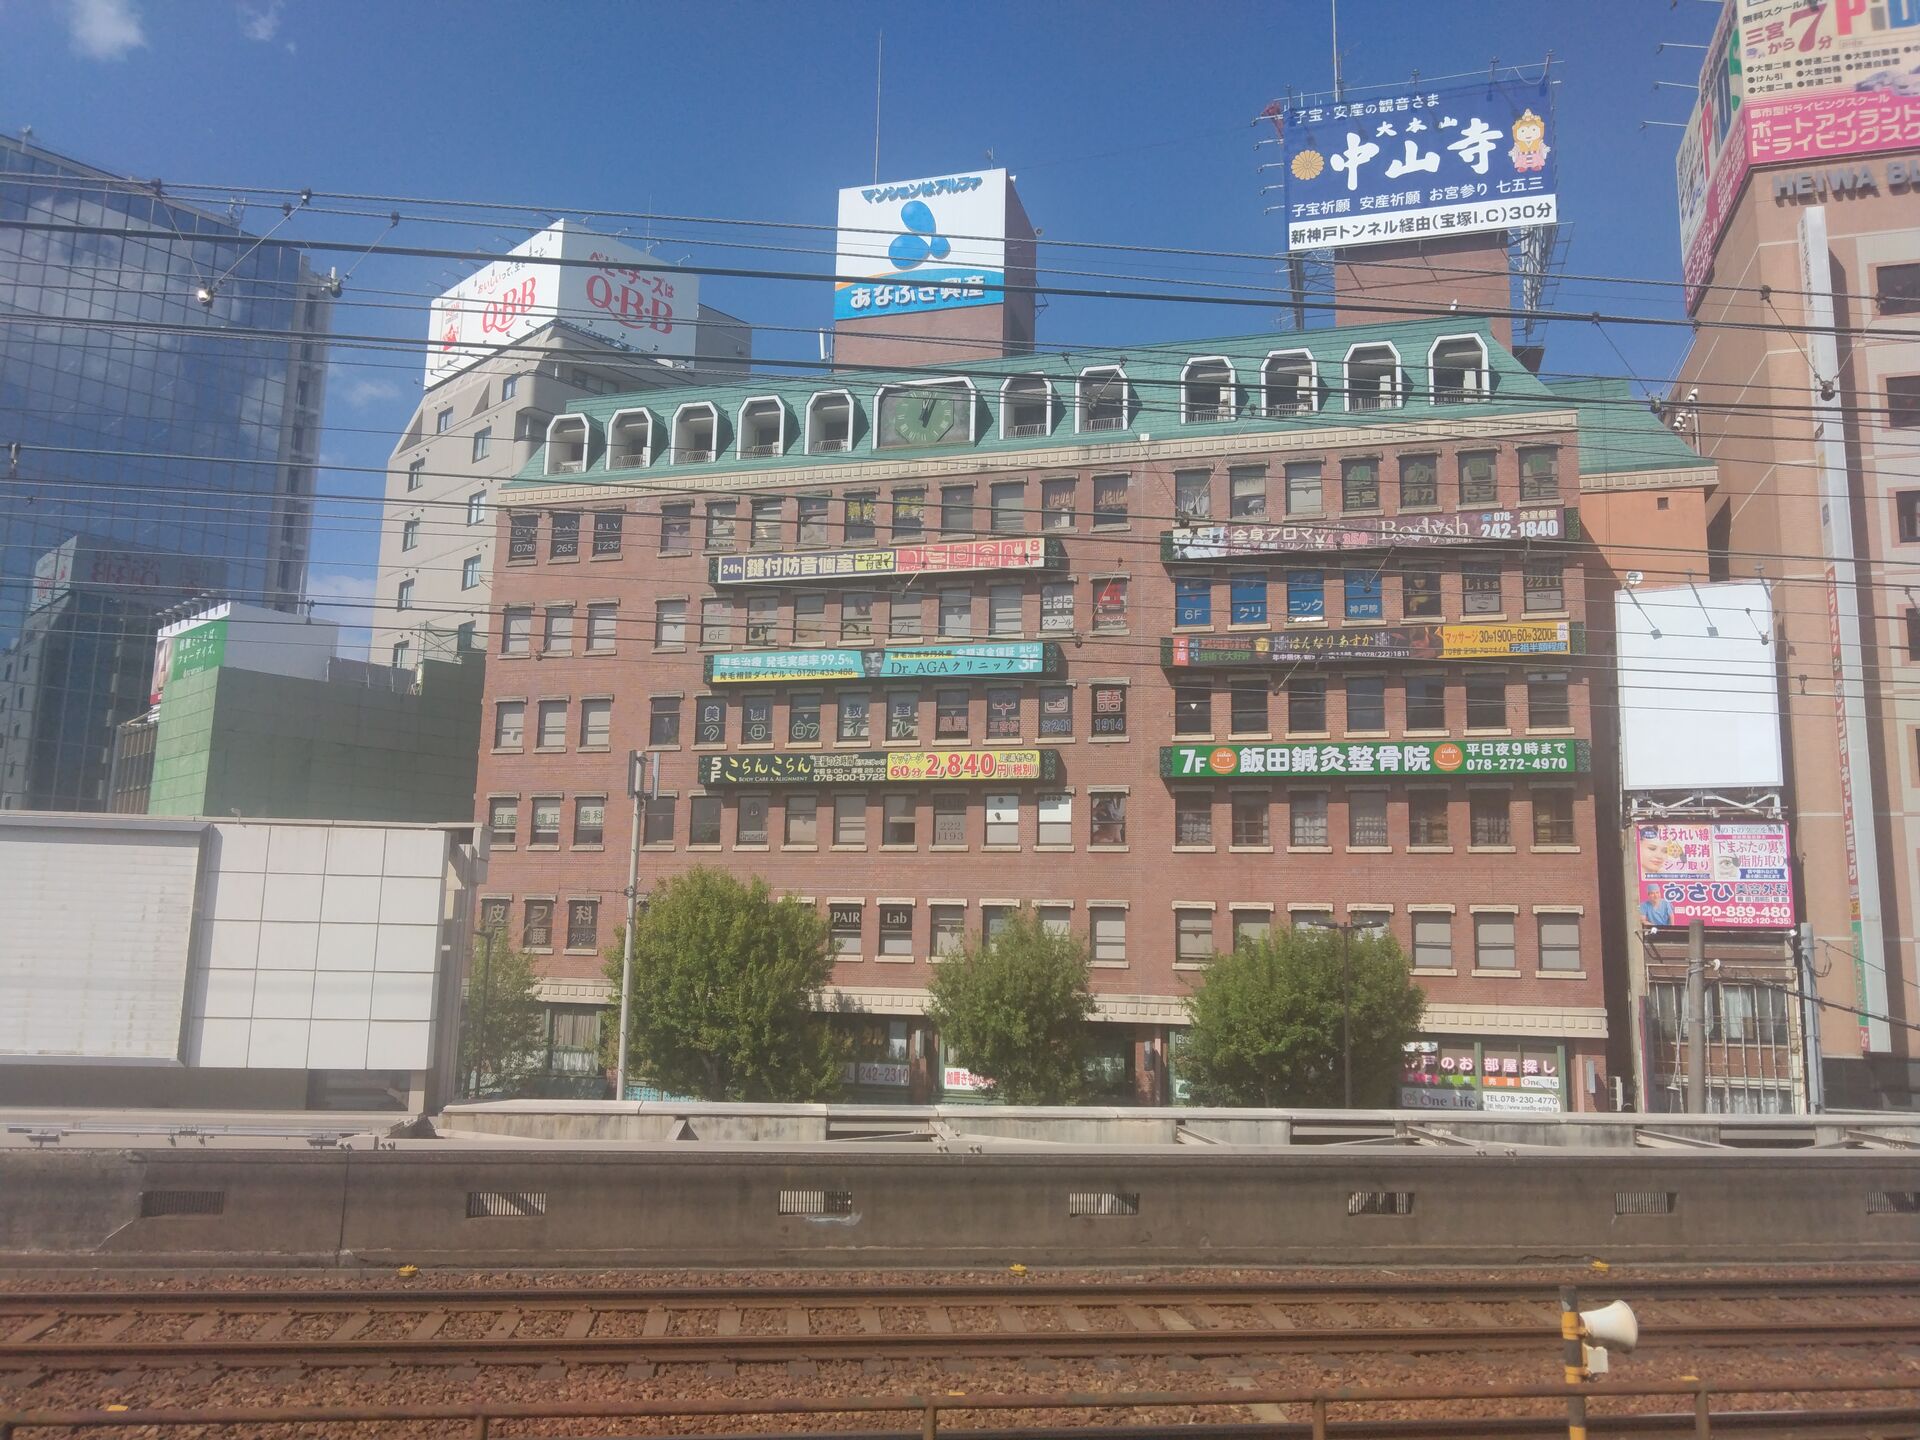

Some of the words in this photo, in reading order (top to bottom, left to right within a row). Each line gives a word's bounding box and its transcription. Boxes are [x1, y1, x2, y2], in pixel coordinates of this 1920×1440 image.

[1745, 21, 1785, 47] 三宮
[1768, 37, 1795, 55] から
[1788, 3, 1828, 52] 7
[1818, 35, 1833, 50] 分
[1756, 73, 1783, 83] けん引
[1294, 93, 1440, 124] 子宝・安産の観音さま
[1375, 117, 1458, 138] 大本山
[1751, 103, 1920, 139] ポートアイランド
[1330, 118, 1504, 191] 中山寺
[1772, 165, 1878, 198] HEIWA
[1291, 198, 1351, 218] 子宝祈願
[1360, 190, 1421, 210] 安産祈願
[1430, 182, 1488, 202] お宮参り
[1496, 176, 1545, 194] 七五三
[1232, 528, 1313, 544] 全身アロマ
[1480, 520, 1559, 539] 242-1840
[722, 564, 742, 574] 24h
[746, 553, 854, 577] 鍵付防音個室
[1464, 579, 1499, 589] Lisa
[1184, 609, 1202, 620] 6F
[1043, 618, 1072, 627] スクール
[708, 630, 725, 641] 6F
[1444, 631, 1480, 643] マッサージ
[1018, 654, 1039, 670] 3F
[1096, 689, 1123, 713] 語
[1094, 718, 1123, 731] 1914
[1466, 742, 1567, 757] 平日夜9時まで
[925, 753, 996, 779] 2,840
[1180, 749, 1207, 774] 7F
[1239, 745, 1431, 773] 飯田鍼灸整骨院
[1466, 757, 1567, 771] 078-272-4970
[813, 773, 886, 782] 078-200-5722
[890, 765, 922, 778] 60分
[1659, 828, 1709, 841] ほうれい線
[1684, 844, 1710, 858] 解消
[1664, 860, 1709, 871] シワ取り
[1740, 854, 1785, 868] 脂肪取り
[1662, 882, 1735, 903] あさひ
[575, 905, 593, 925] 科
[833, 911, 860, 923] PAIR
[887, 911, 907, 924] Lab
[1685, 905, 1791, 918] 0120-889-480
[1420, 1094, 1448, 1107] One
